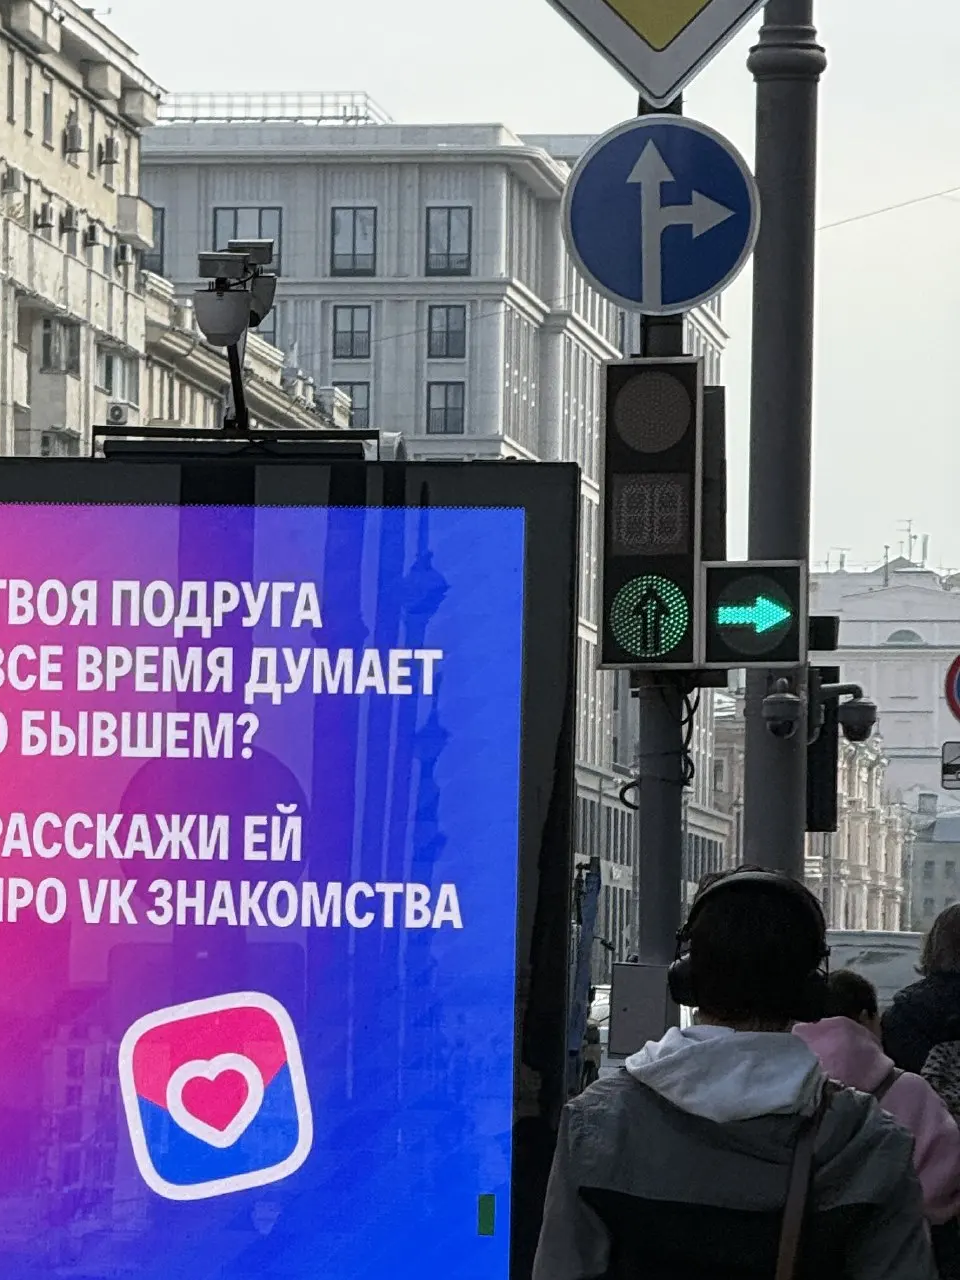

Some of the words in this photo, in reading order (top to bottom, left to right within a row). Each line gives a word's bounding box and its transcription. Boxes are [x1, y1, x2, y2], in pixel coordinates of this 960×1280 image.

[112, 580, 323, 638] ПОДРУГА
[77, 646, 233, 693] ВРЕМЯ
[244, 648, 443, 704] ДУМАЕТ
[21, 711, 259, 759] БЫВШЕМ?
[244, 803, 302, 862] ЕЙ
[78, 879, 138, 924] VK
[146, 880, 463, 929] ЗНАКОМСТВА
